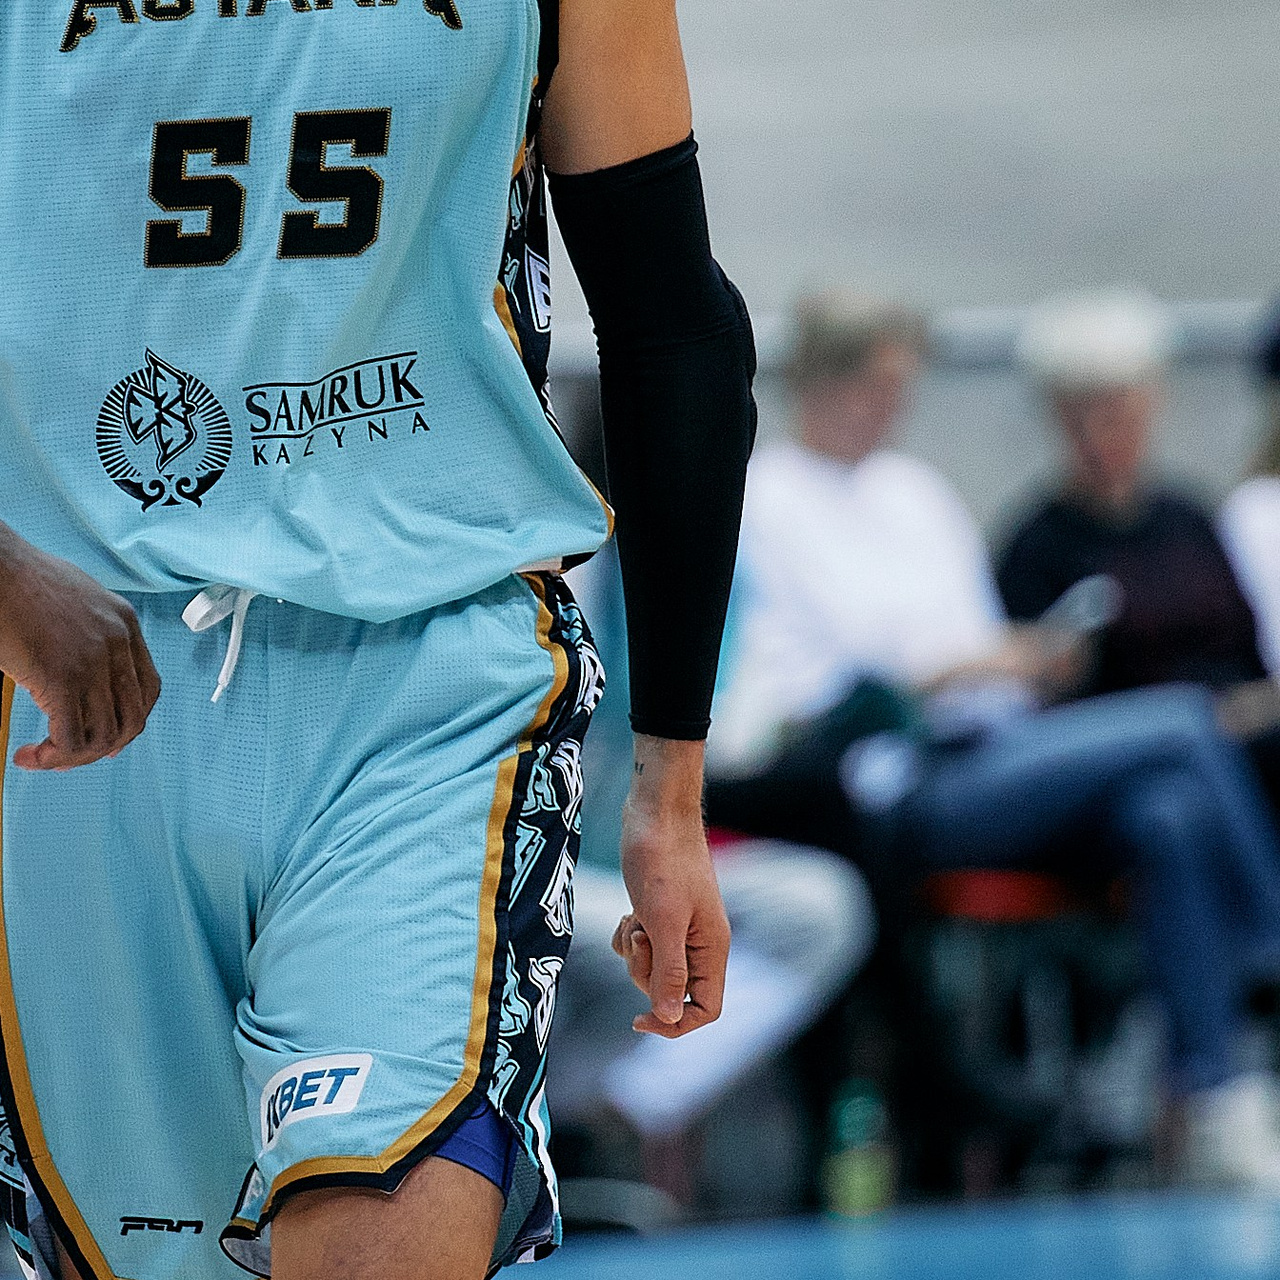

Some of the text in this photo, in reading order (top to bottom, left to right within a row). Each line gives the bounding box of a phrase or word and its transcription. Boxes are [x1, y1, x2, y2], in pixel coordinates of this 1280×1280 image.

[143, 106, 392, 269] 55
[245, 358, 424, 434] SAMRUK
[252, 410, 431, 467] KAZYNA
